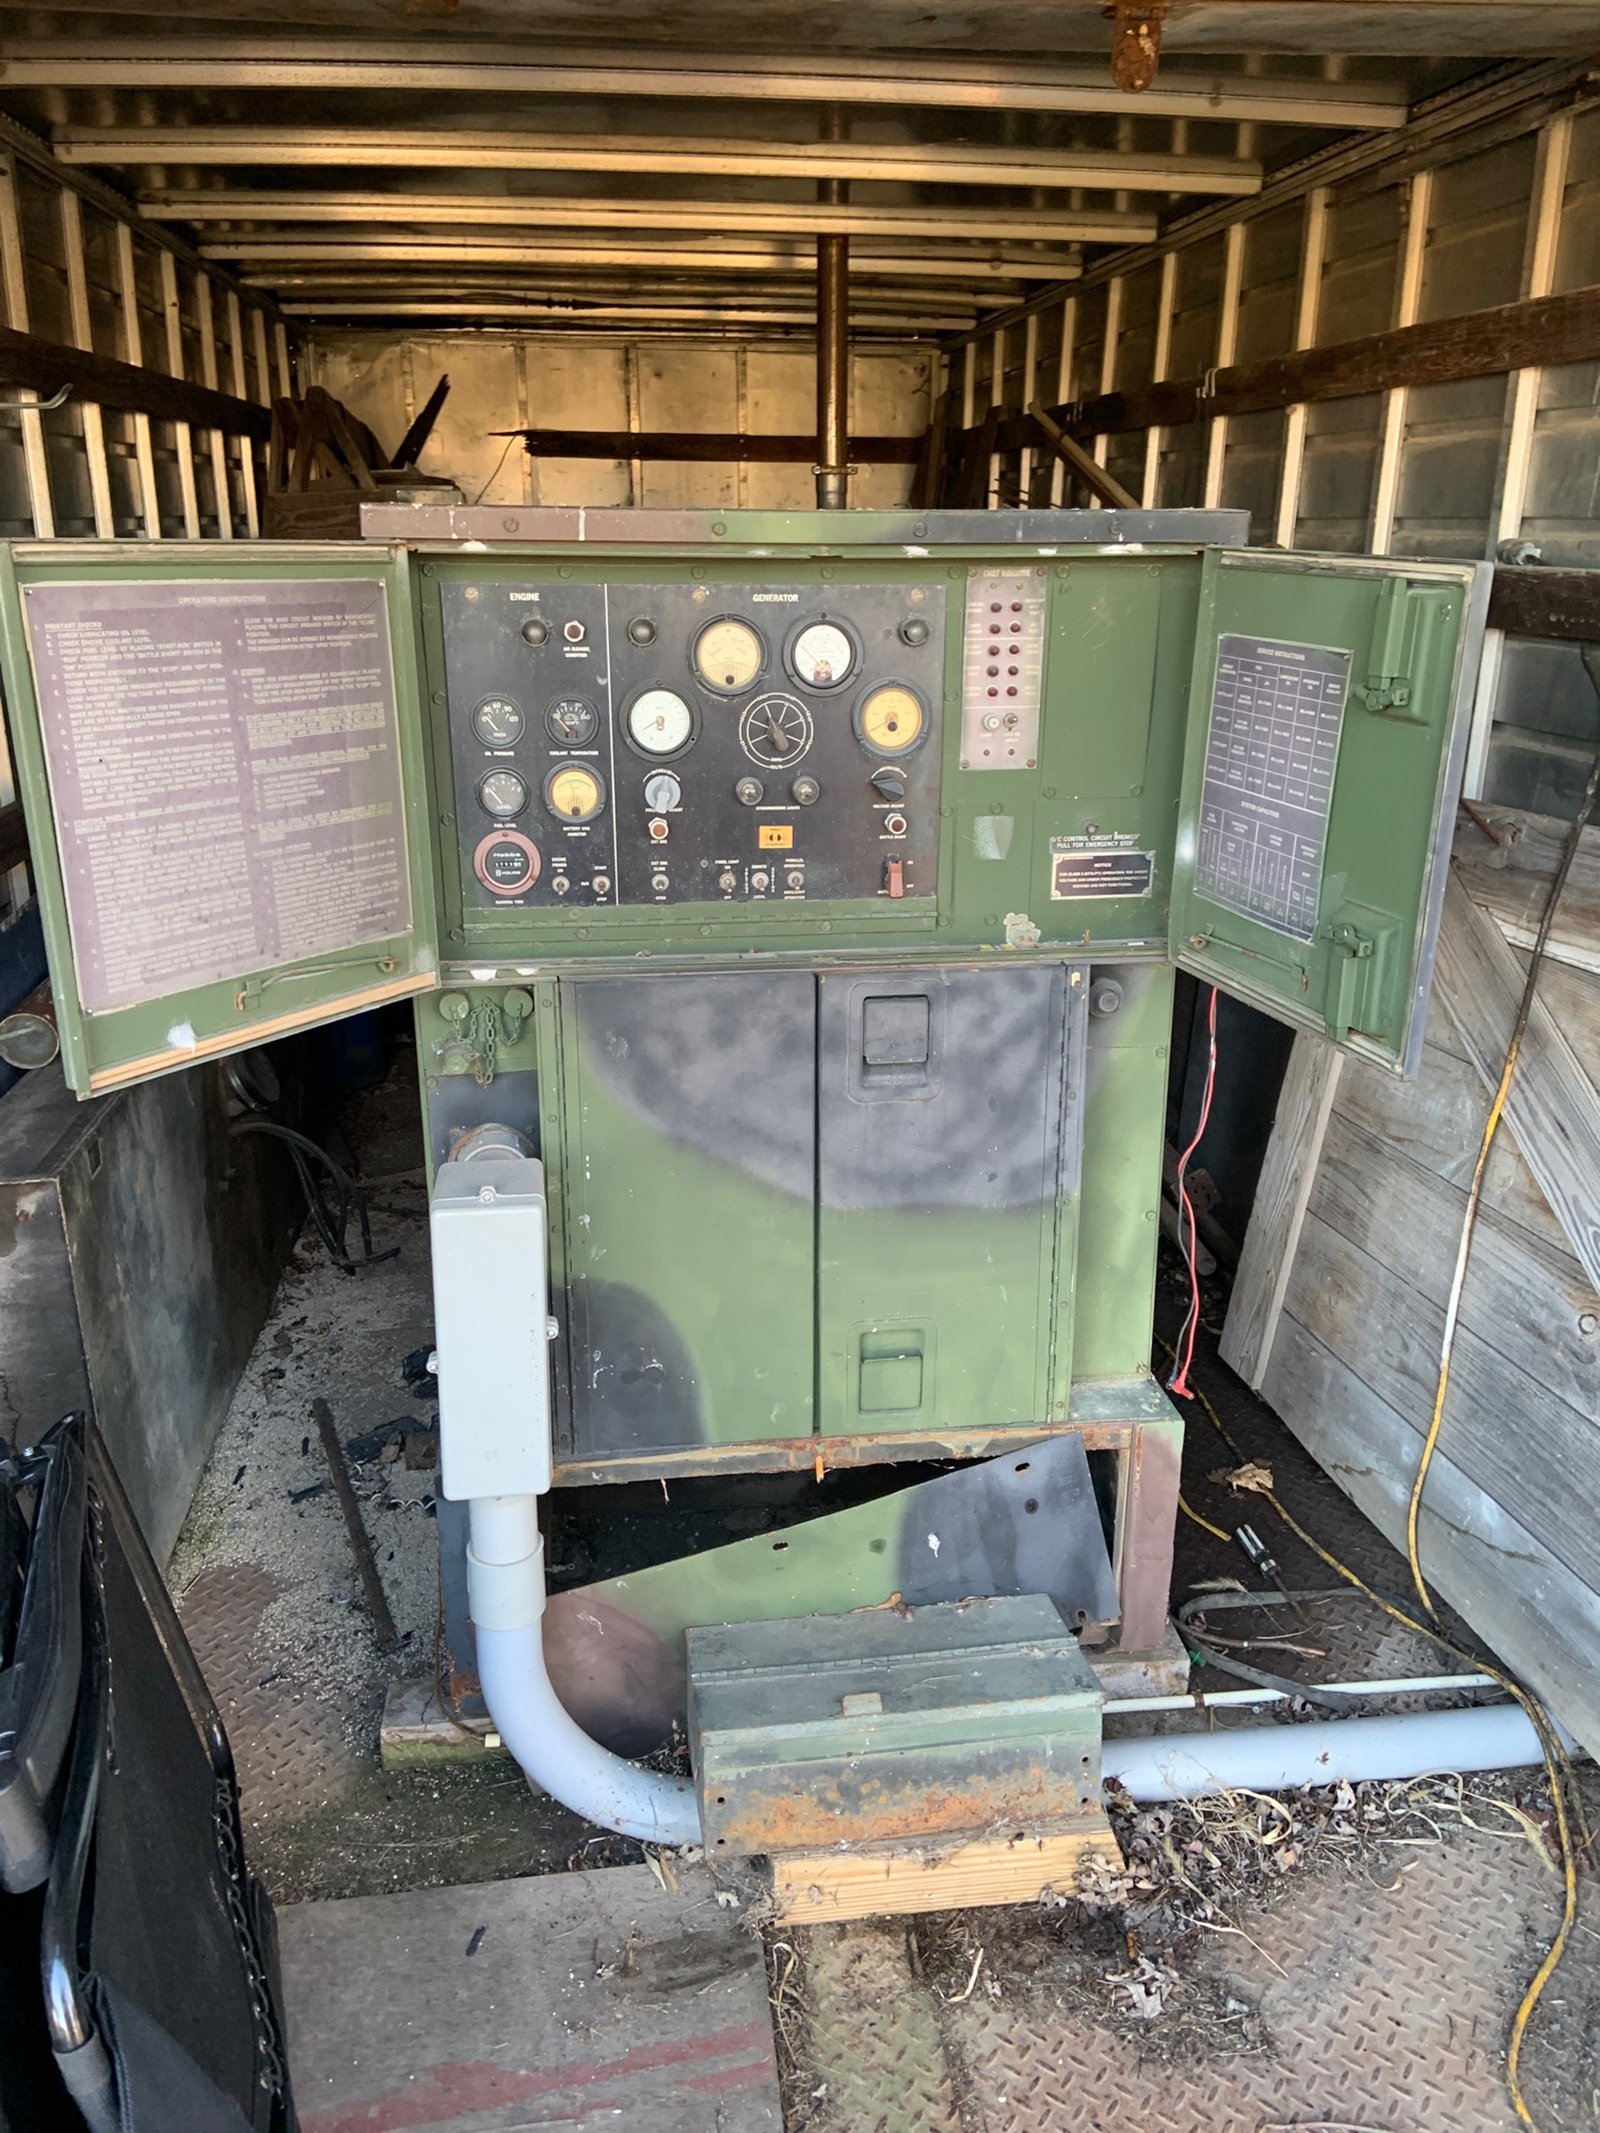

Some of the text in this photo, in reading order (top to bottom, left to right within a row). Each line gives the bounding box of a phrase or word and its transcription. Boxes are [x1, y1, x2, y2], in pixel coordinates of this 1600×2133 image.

[178, 595, 266, 605] OPERATING INSTRUCTIONS
[510, 592, 540, 601] ENGINE
[752, 594, 799, 602] GENERATOR
[1086, 840, 1119, 848] EMERGENCY
